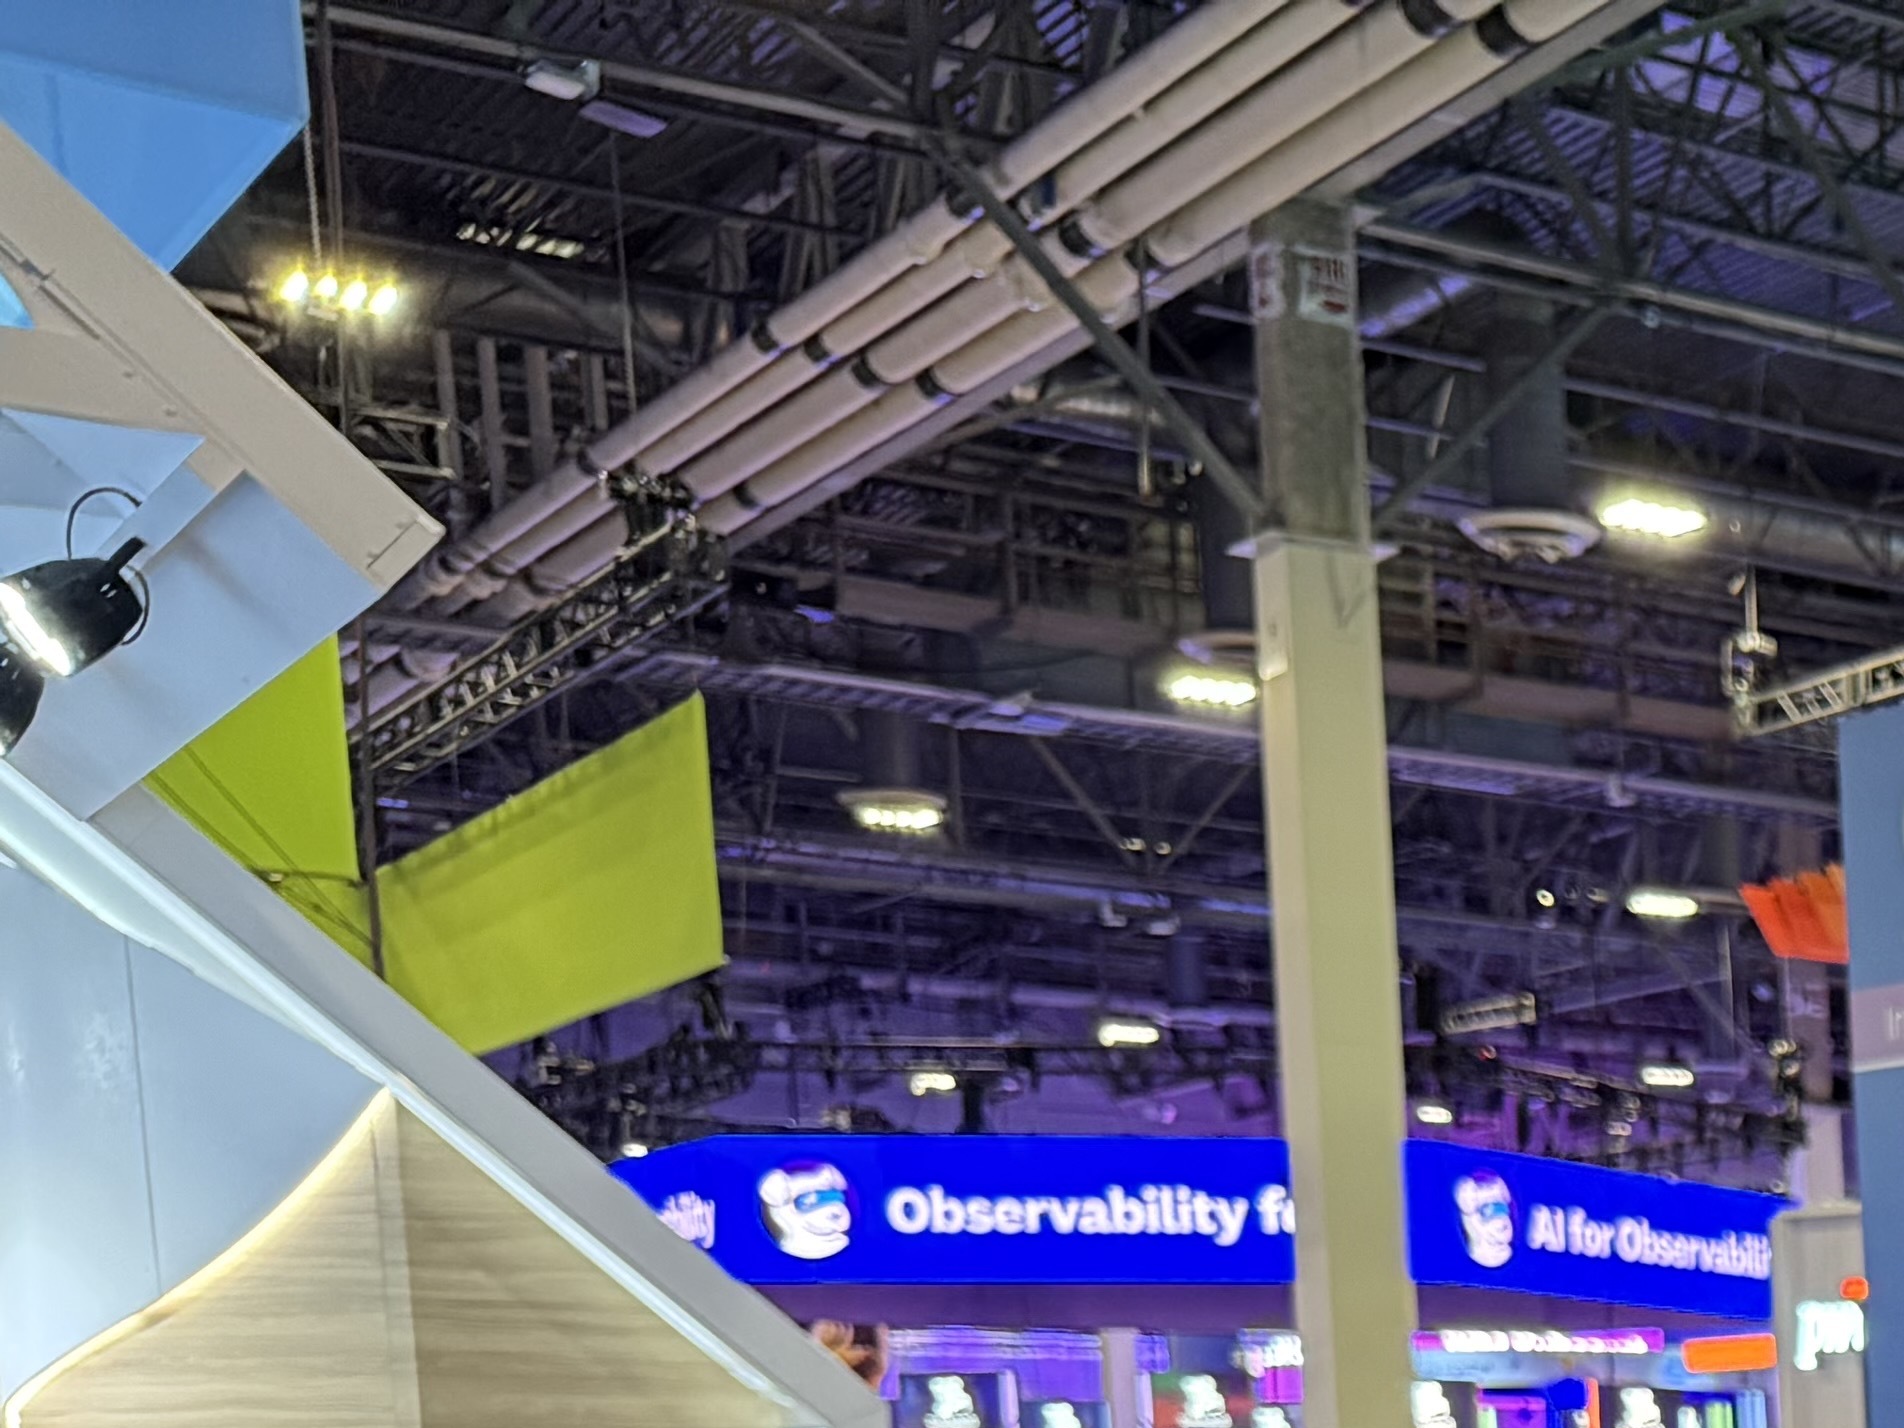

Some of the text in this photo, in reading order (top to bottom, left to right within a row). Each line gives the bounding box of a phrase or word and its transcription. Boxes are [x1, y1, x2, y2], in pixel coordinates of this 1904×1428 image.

[885, 1183, 1251, 1247] Observability
[1527, 1204, 1772, 1281] AI for Observabili
